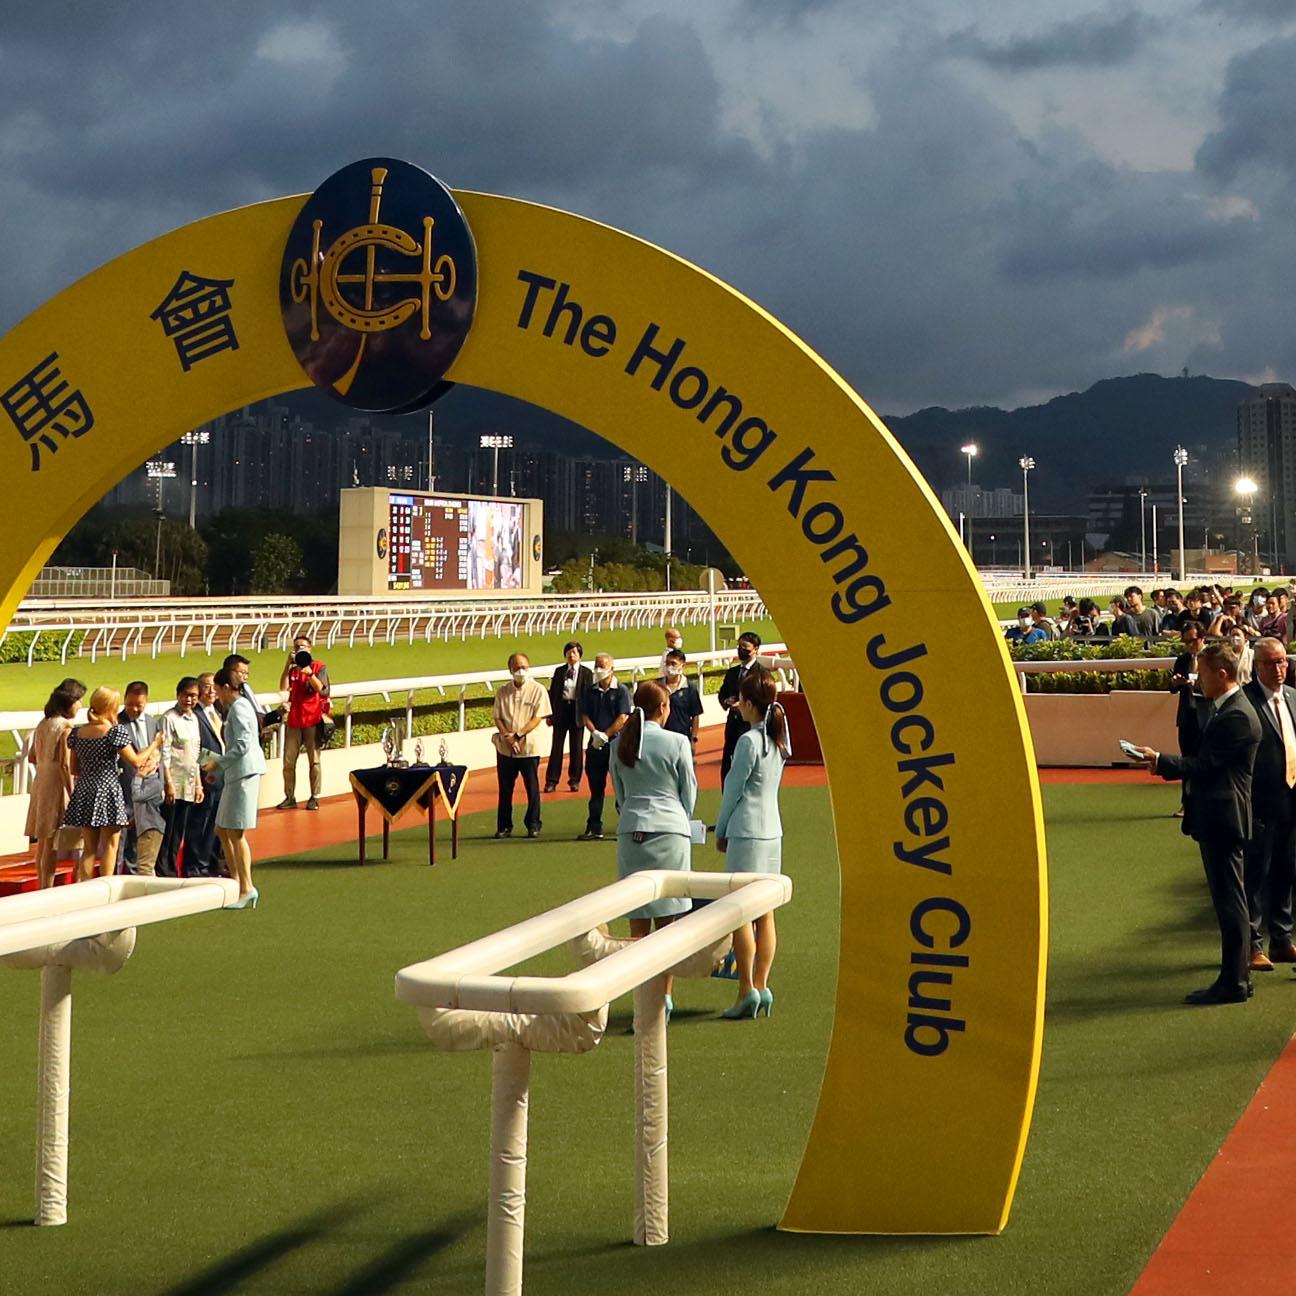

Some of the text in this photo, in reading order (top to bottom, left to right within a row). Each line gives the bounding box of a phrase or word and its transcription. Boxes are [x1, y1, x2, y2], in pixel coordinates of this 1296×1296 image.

[517, 270, 971, 1057] The Hong Kong Jockey Club
